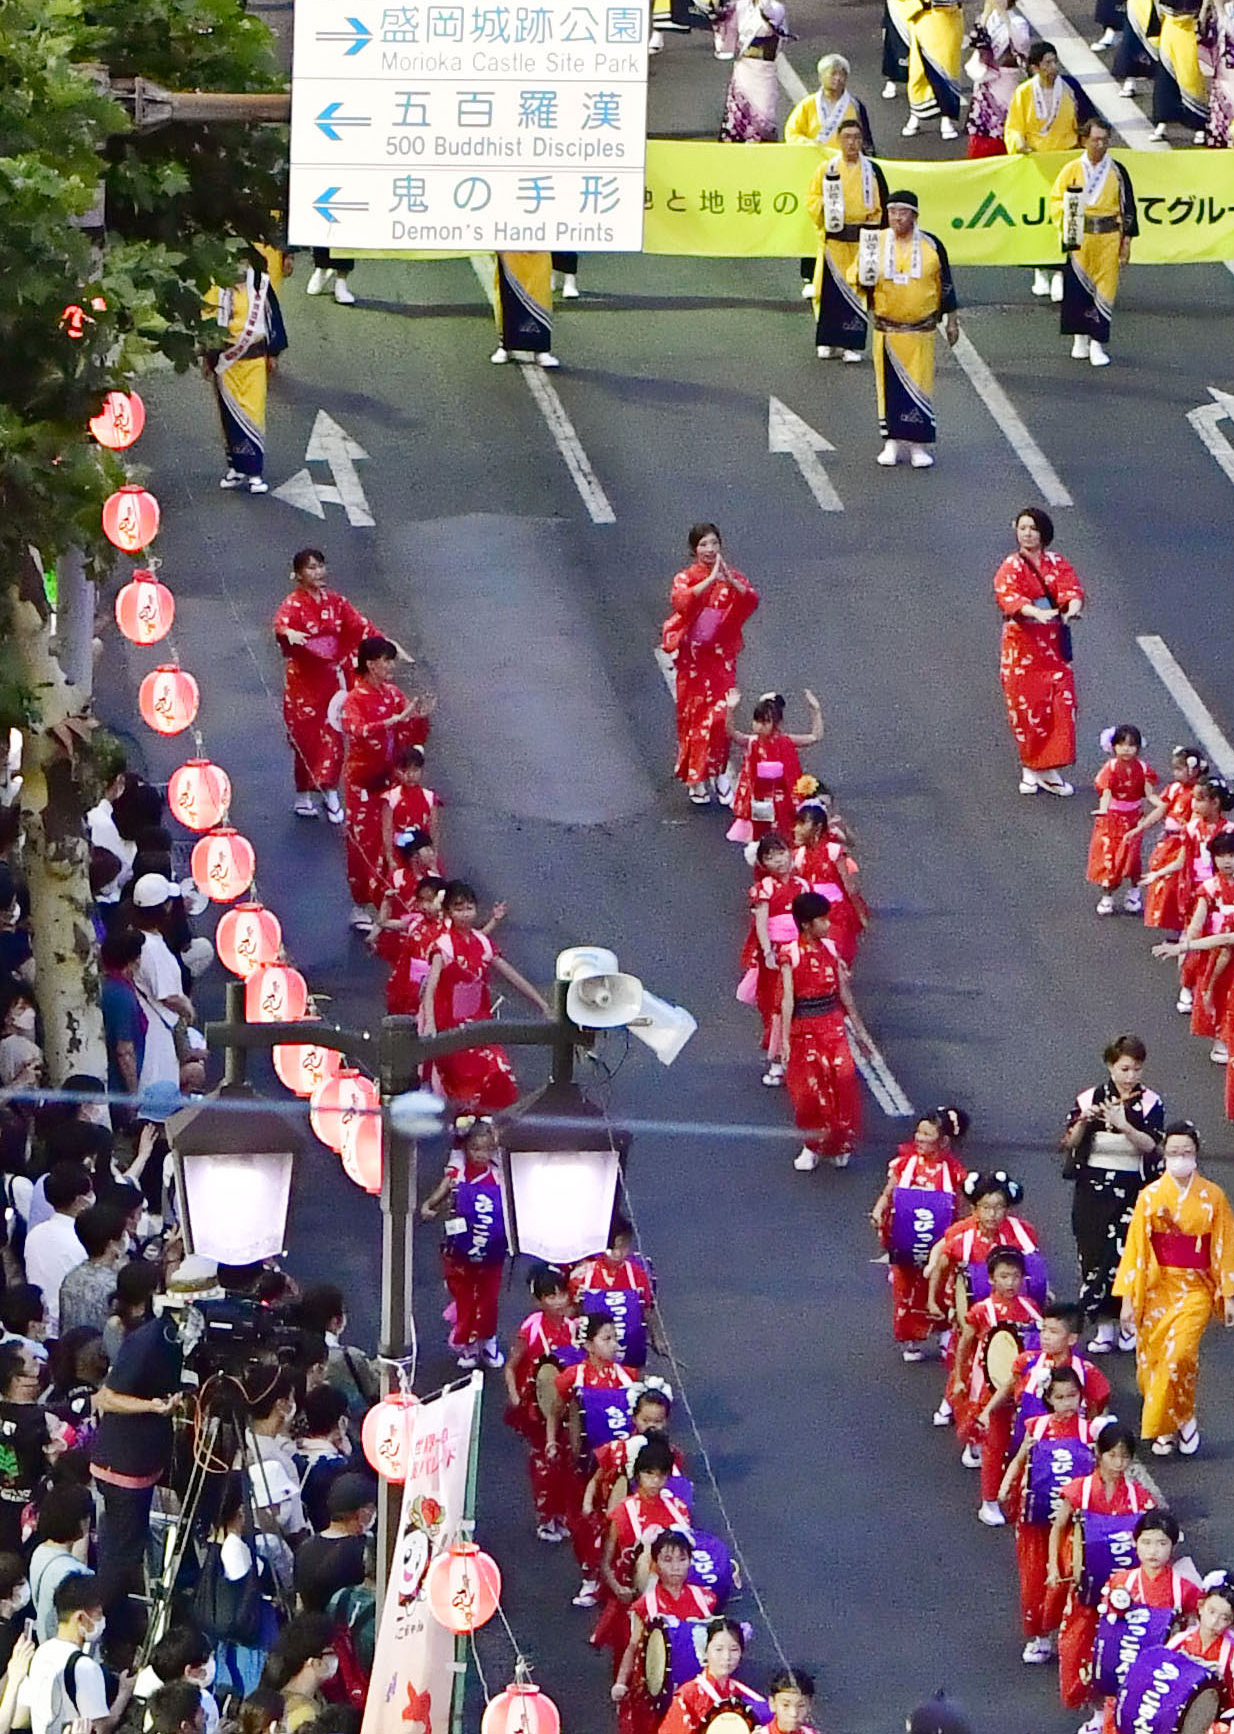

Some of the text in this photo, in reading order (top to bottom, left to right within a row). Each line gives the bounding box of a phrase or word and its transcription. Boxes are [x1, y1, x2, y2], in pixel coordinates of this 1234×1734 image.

[379, 5, 644, 45] 盛岡城跡公園
[381, 51, 640, 74] Morioka Castle Site Park
[391, 90, 623, 131] 五百羅漢
[385, 136, 625, 162] 500 Buddhist Disciples
[388, 174, 621, 215] 鬼の手形
[391, 220, 614, 243] Demon's Hand Prints
